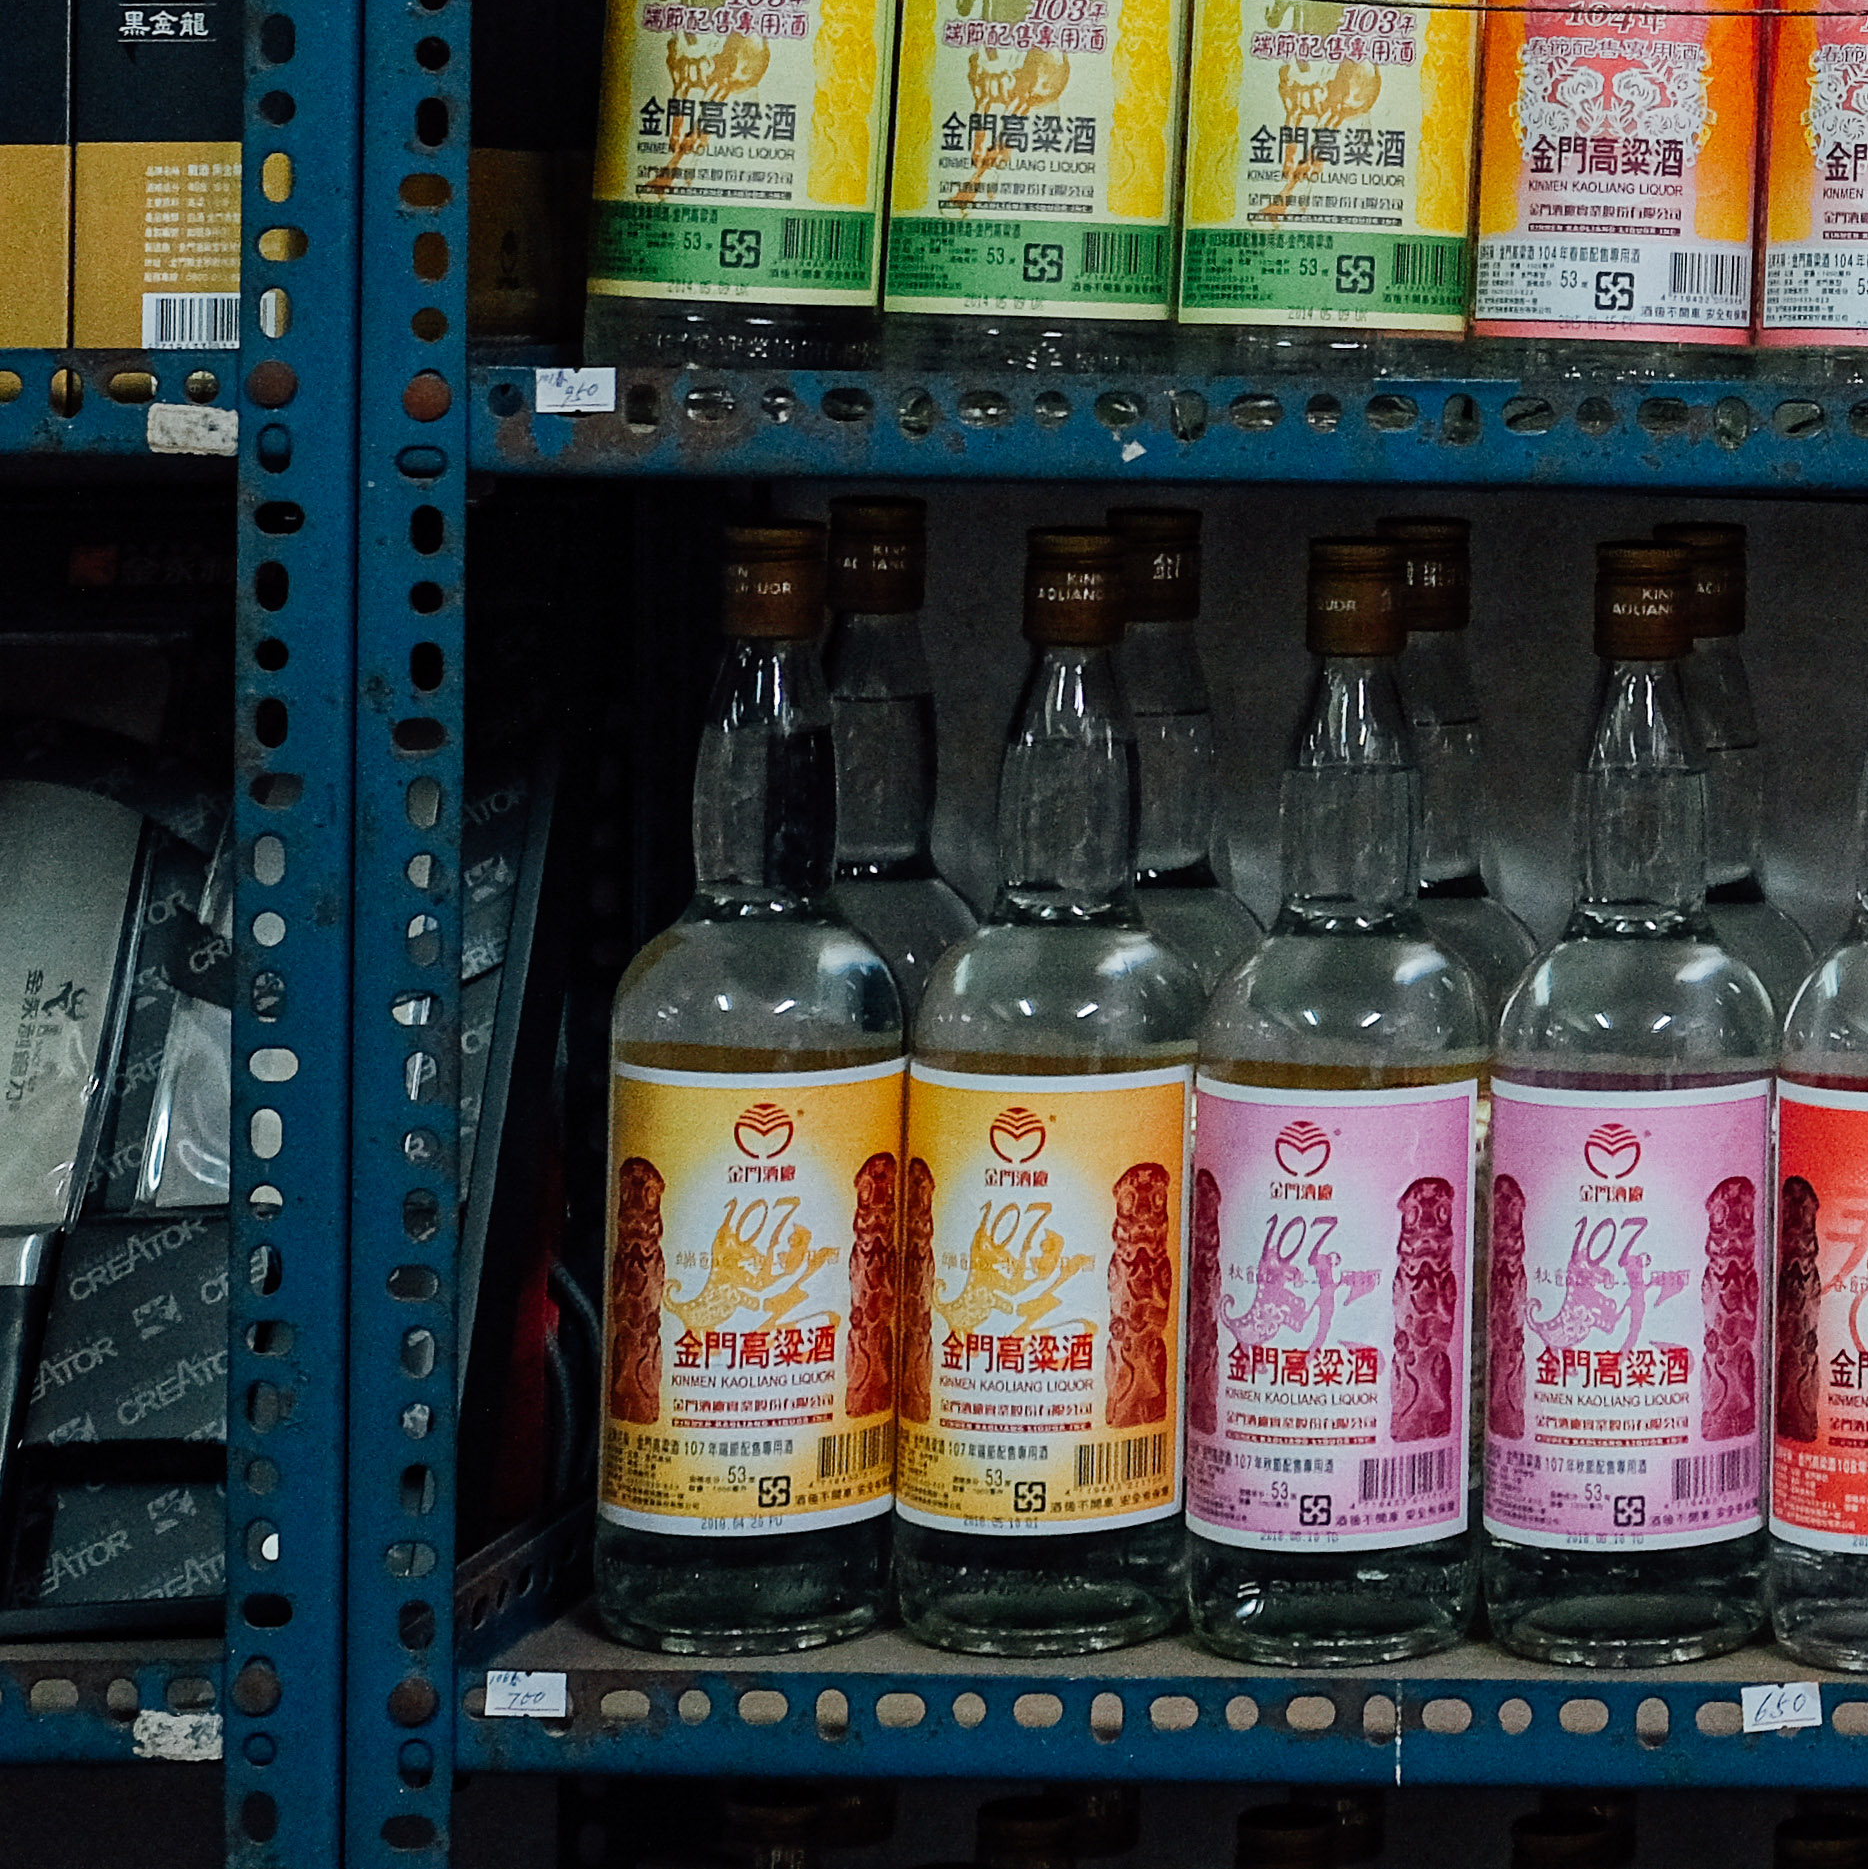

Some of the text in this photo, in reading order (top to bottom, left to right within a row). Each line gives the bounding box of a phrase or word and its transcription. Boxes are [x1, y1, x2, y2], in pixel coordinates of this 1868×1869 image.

[118, 9, 209, 38] 黑金龍
[639, 96, 796, 142] 金門高粱酒
[940, 112, 1096, 155] 金門高粱酒
[1249, 125, 1405, 168] 金門高粱酒
[1529, 135, 1683, 178] 金門高粱酒
[1529, 180, 1683, 197] KINMEN KAOLIANG LIQUOR
[1823, 187, 1863, 201] KINMEN
[673, 1327, 835, 1371] 金門高粱酒
[940, 1334, 1093, 1375] 金門高粱酒
[1226, 1348, 1378, 1388] 金門高粱酒
[1535, 1348, 1690, 1387] 金門高粱酒
[671, 1371, 835, 1389] KINMEN KAOLIANG LIQUOR
